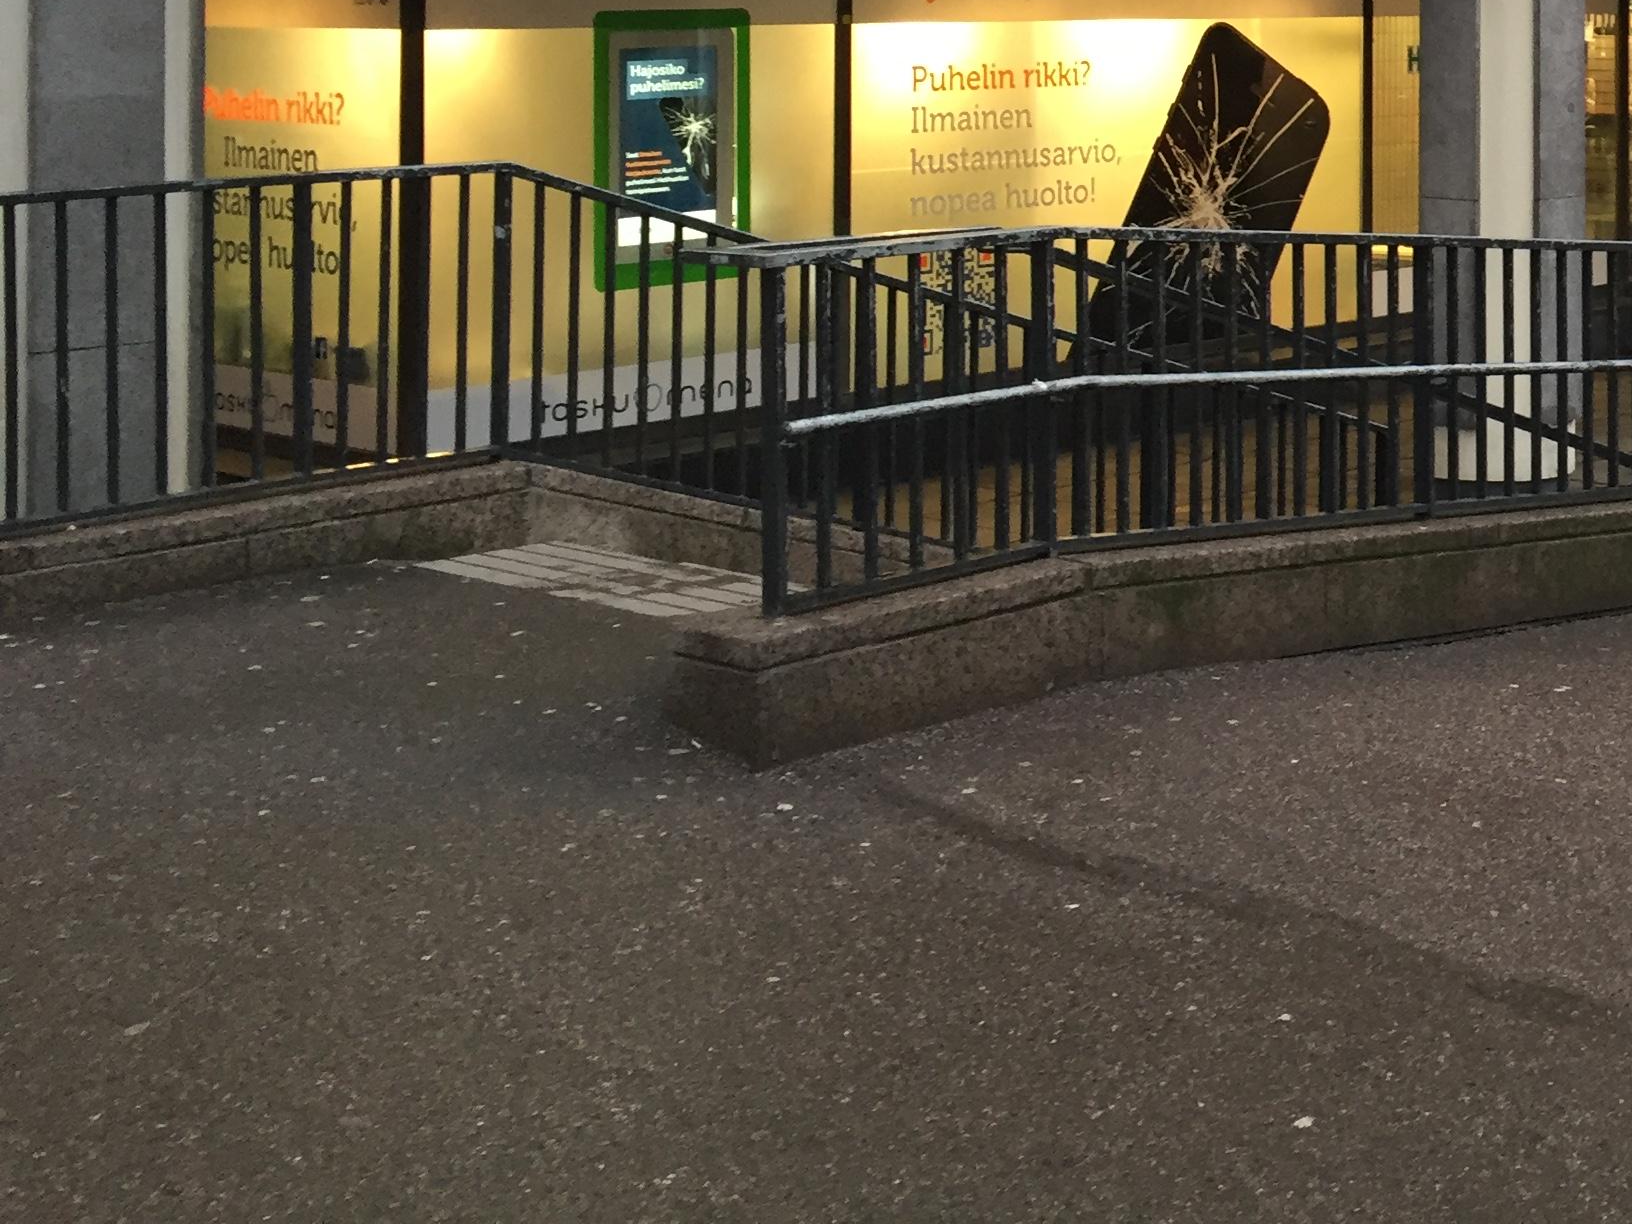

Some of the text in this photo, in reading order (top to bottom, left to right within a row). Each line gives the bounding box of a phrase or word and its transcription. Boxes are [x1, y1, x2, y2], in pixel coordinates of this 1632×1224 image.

[629, 77, 705, 96] puhelimesi?
[630, 63, 685, 79] Hajosiko
[912, 60, 1091, 92] Puhelin rikki?
[285, 91, 345, 126] rikki?
[911, 104, 1033, 134] Ilmainen
[223, 135, 319, 173] Ilmainen
[910, 138, 1122, 176] kustannusarvio,
[910, 177, 1096, 217] nopea huolto!
